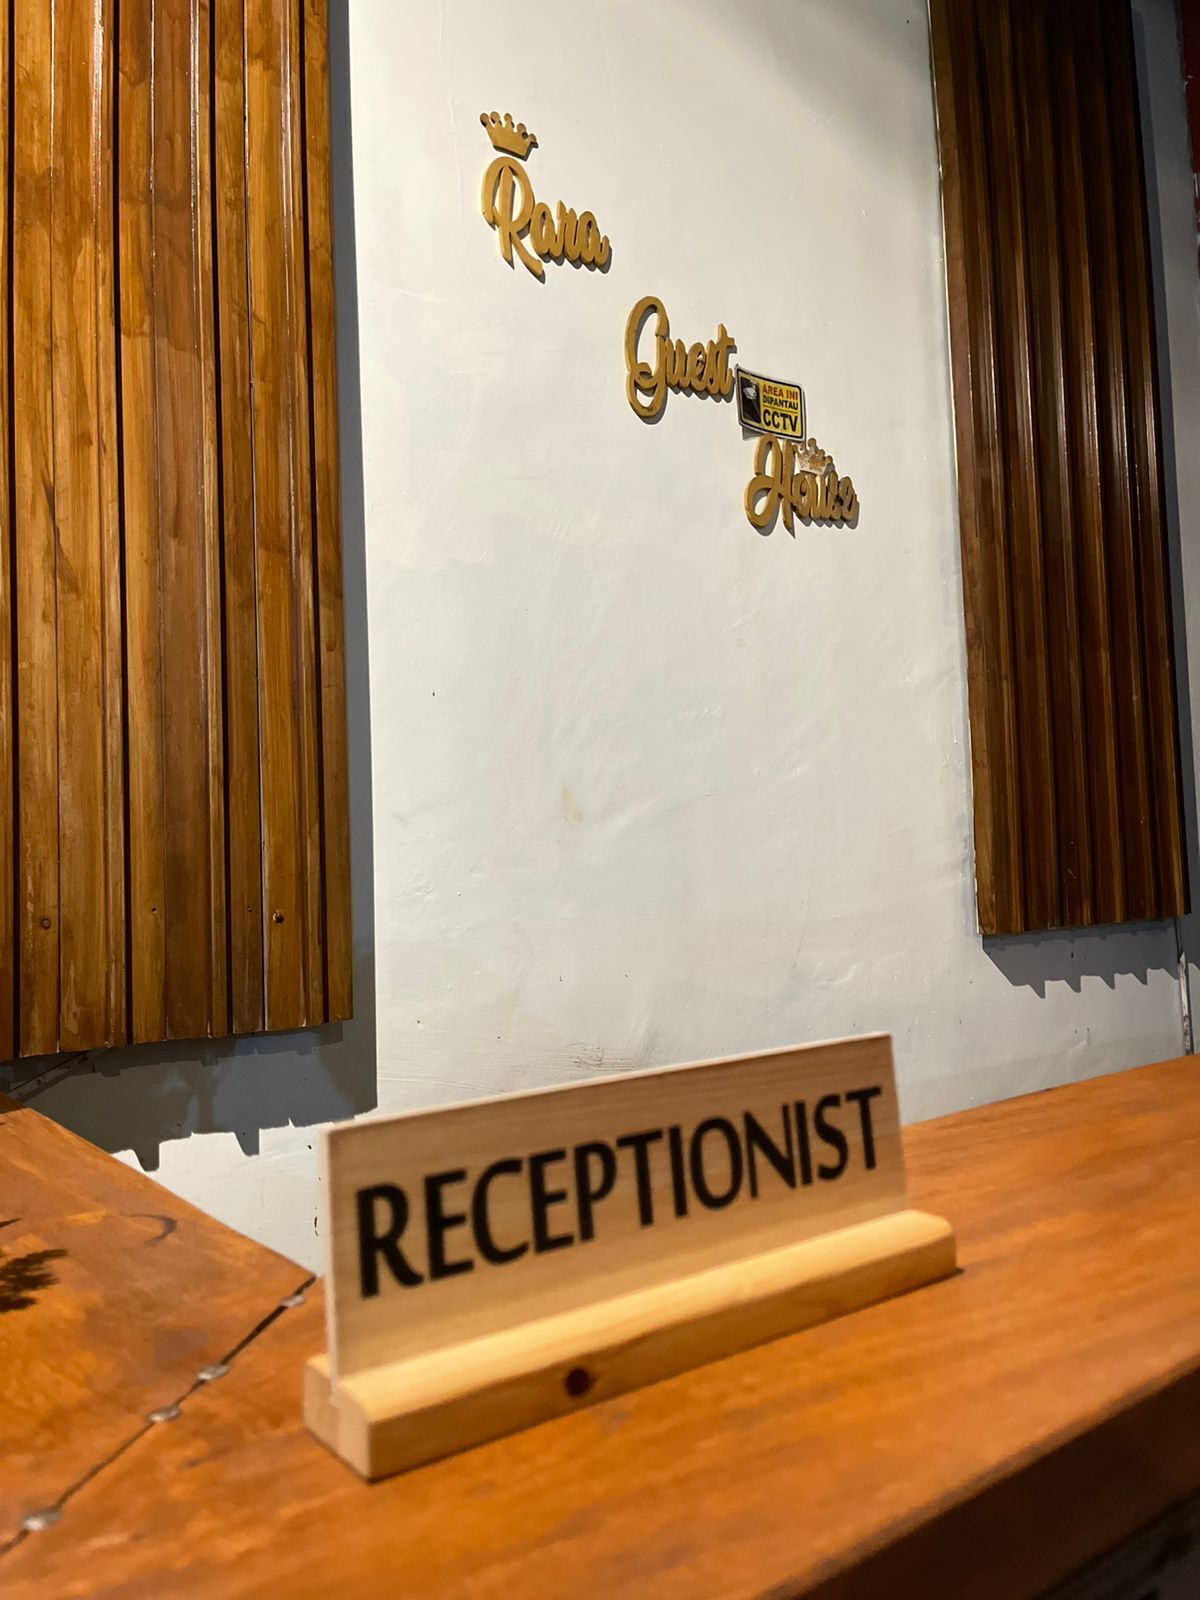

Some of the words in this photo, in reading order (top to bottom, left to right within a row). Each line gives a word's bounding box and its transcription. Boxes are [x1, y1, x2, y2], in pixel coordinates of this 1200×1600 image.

[624, 295, 736, 418] Guest
[762, 384, 784, 397] AREA
[786, 389, 799, 401] INI
[762, 395, 798, 410] DIPANTAU
[763, 409, 798, 432] CCTV
[743, 433, 858, 531] House
[355, 1085, 884, 1300] RECEPTIONIST
